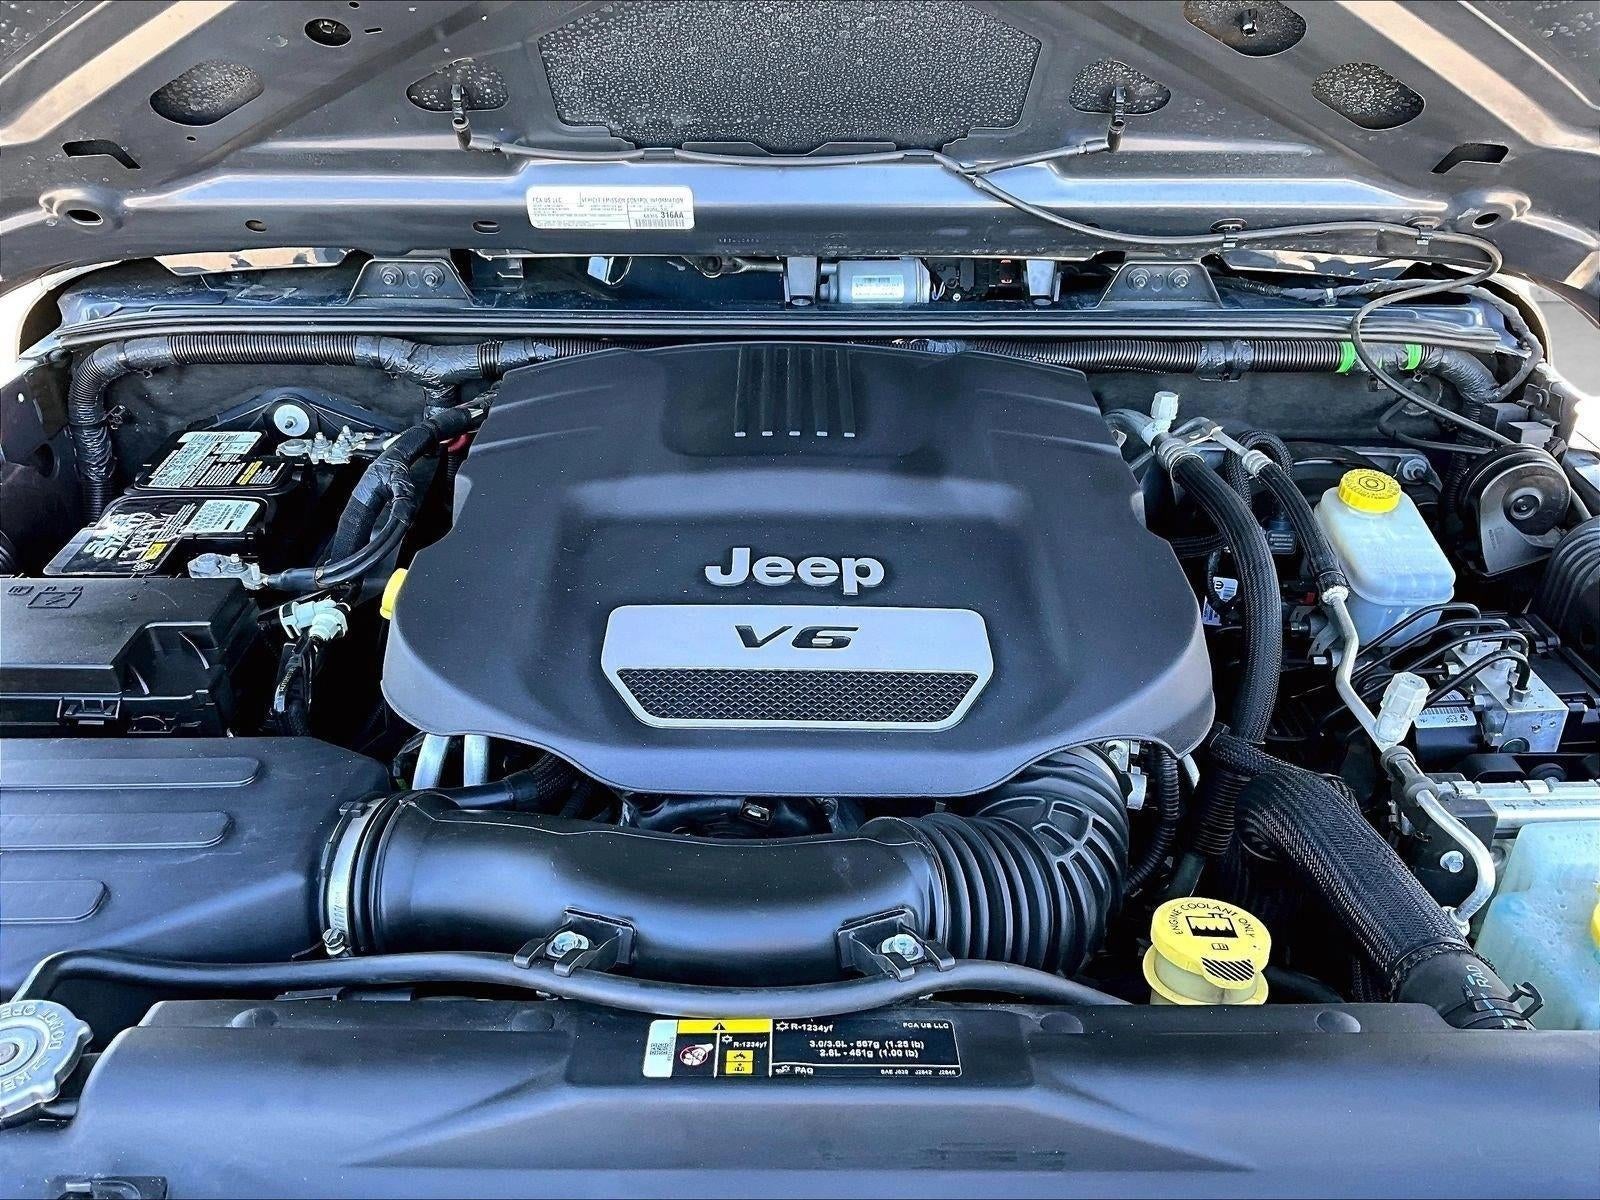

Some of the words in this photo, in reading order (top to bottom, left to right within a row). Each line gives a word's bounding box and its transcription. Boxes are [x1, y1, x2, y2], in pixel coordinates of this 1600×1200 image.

[660, 211, 684, 219] 316AA
[704, 547, 885, 595] Jeep
[735, 625, 859, 648] V6
[1169, 908, 1183, 935] ENGINE
[1181, 903, 1238, 917] COOLANT
[1238, 917, 1256, 938] ONLY
[791, 1022, 833, 1032] R-1234yf
